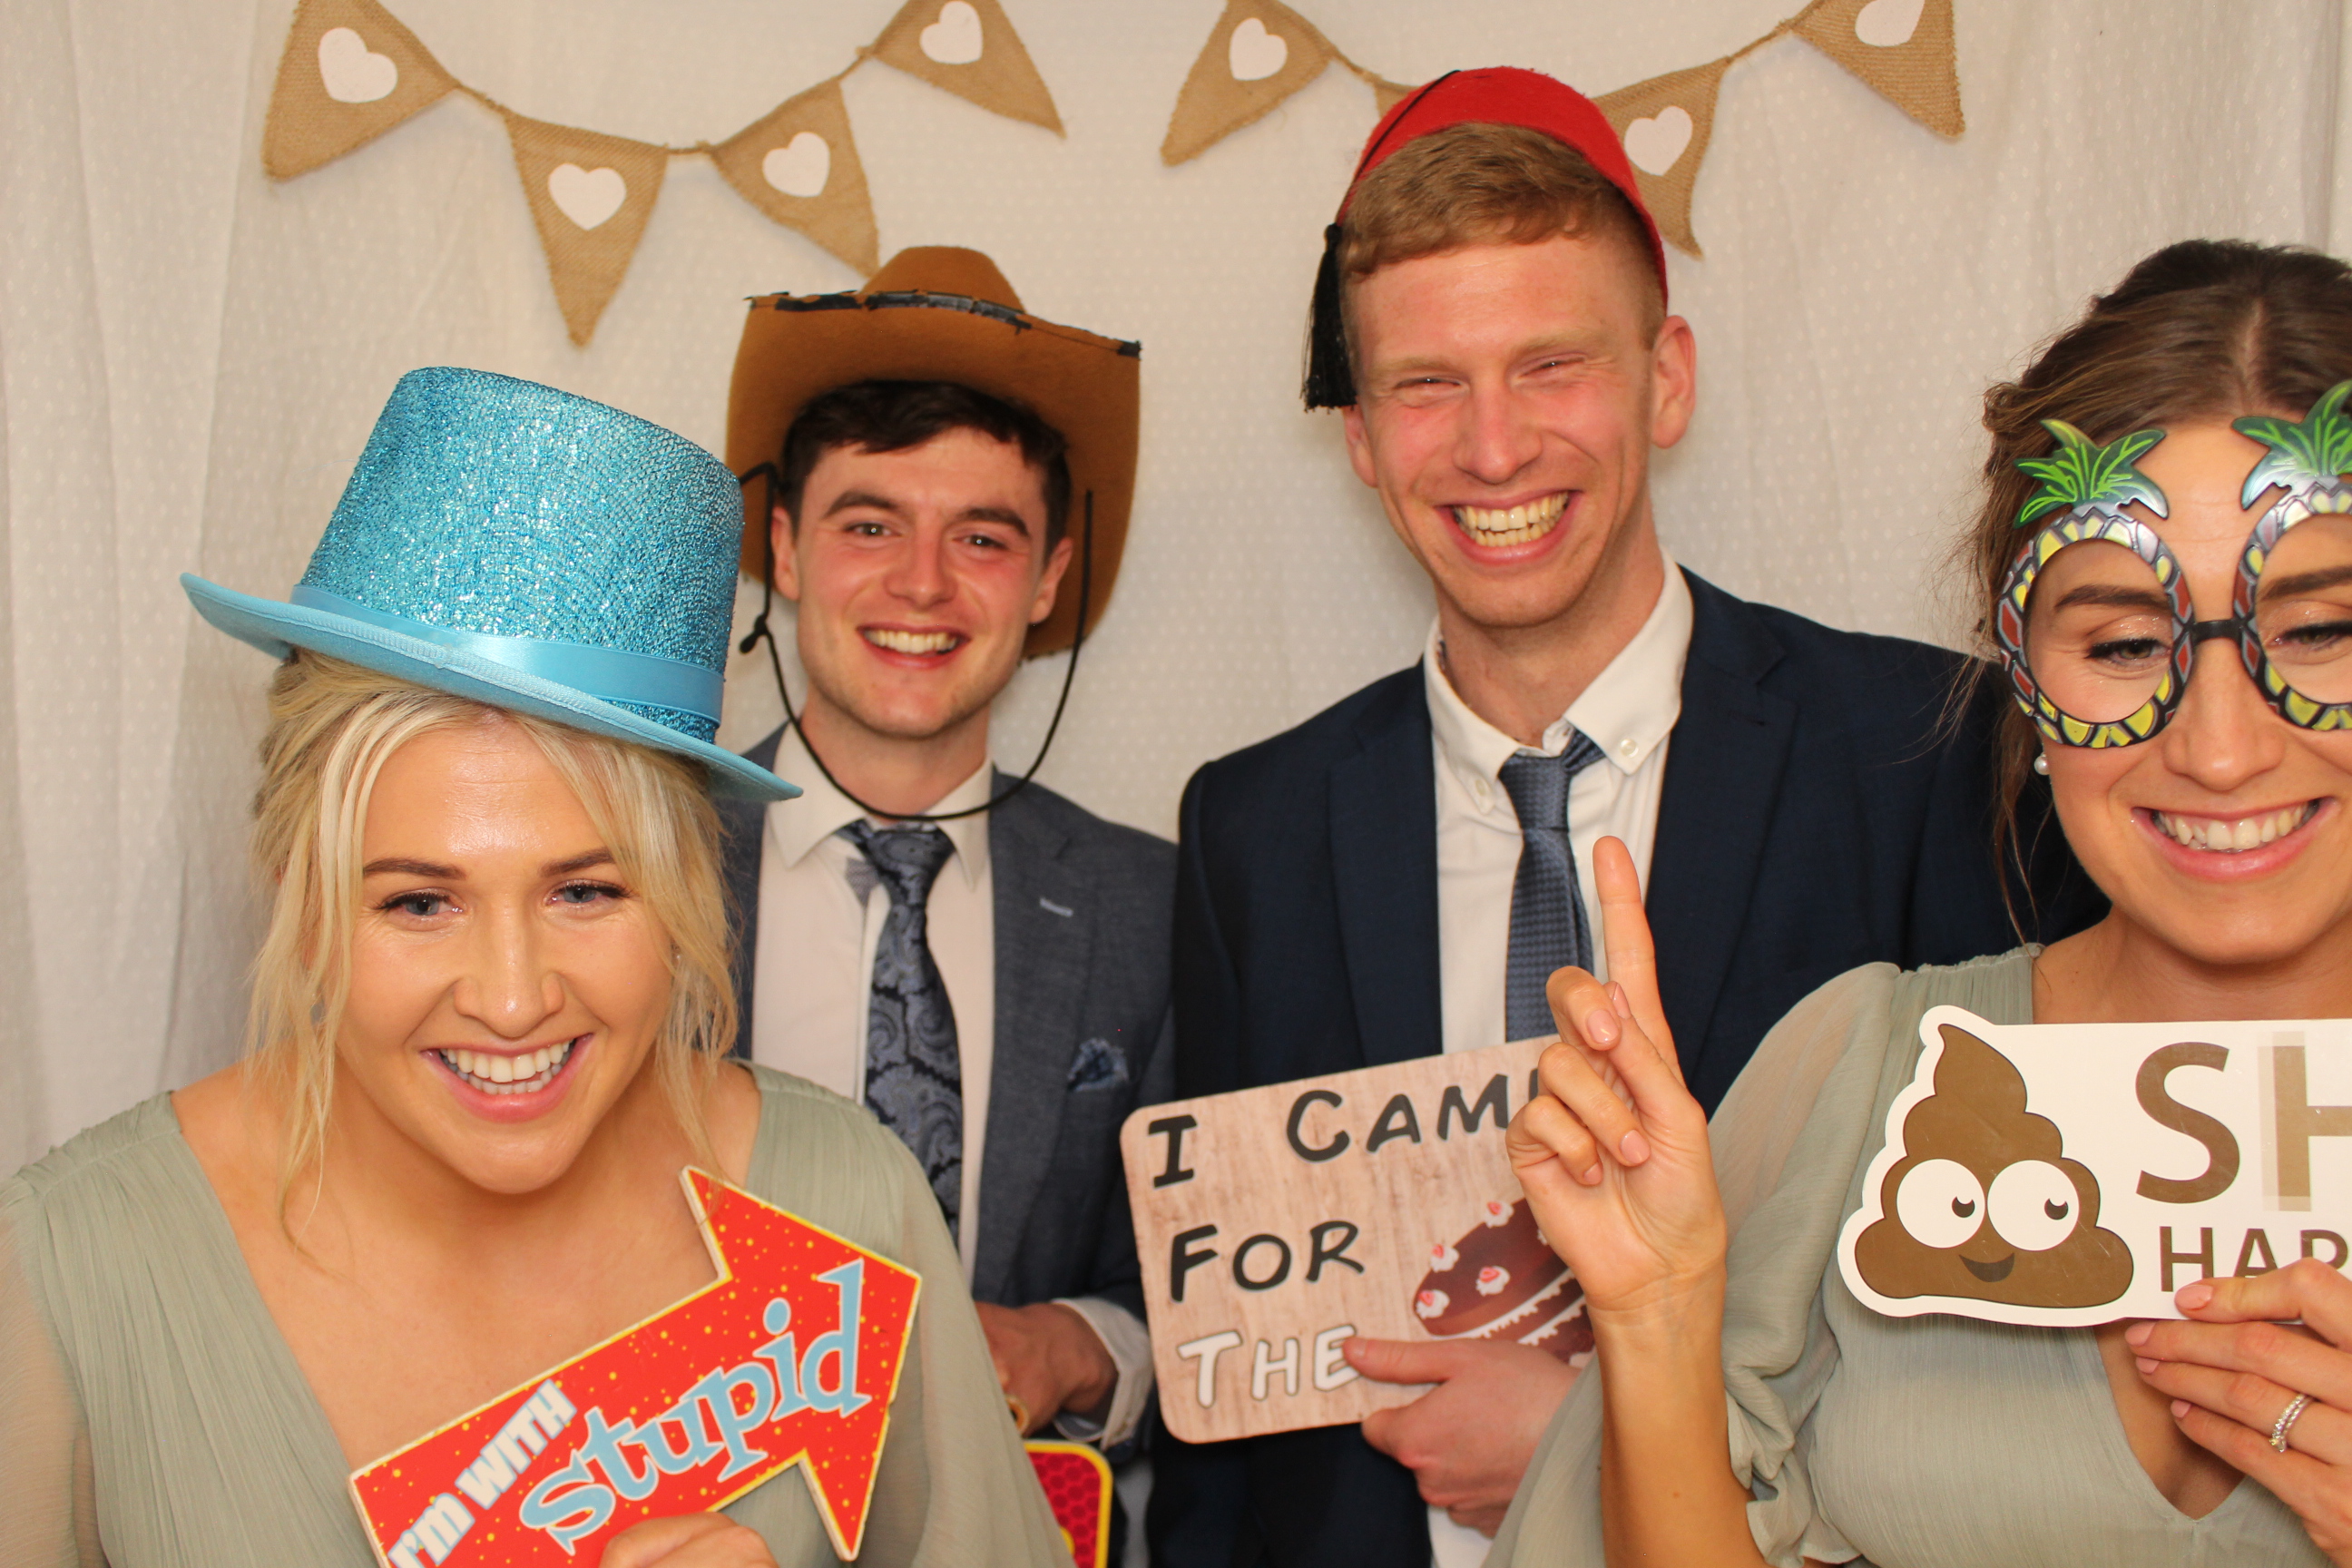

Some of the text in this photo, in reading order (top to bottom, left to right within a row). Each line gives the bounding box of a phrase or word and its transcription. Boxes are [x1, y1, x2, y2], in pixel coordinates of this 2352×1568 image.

[1148, 1067, 1539, 1190] I CAM
[1170, 1220, 1365, 1303] FOR
[518, 1257, 872, 1555] stupid
[1177, 1324, 1362, 1409] THE
[454, 1377, 578, 1511] WITH
